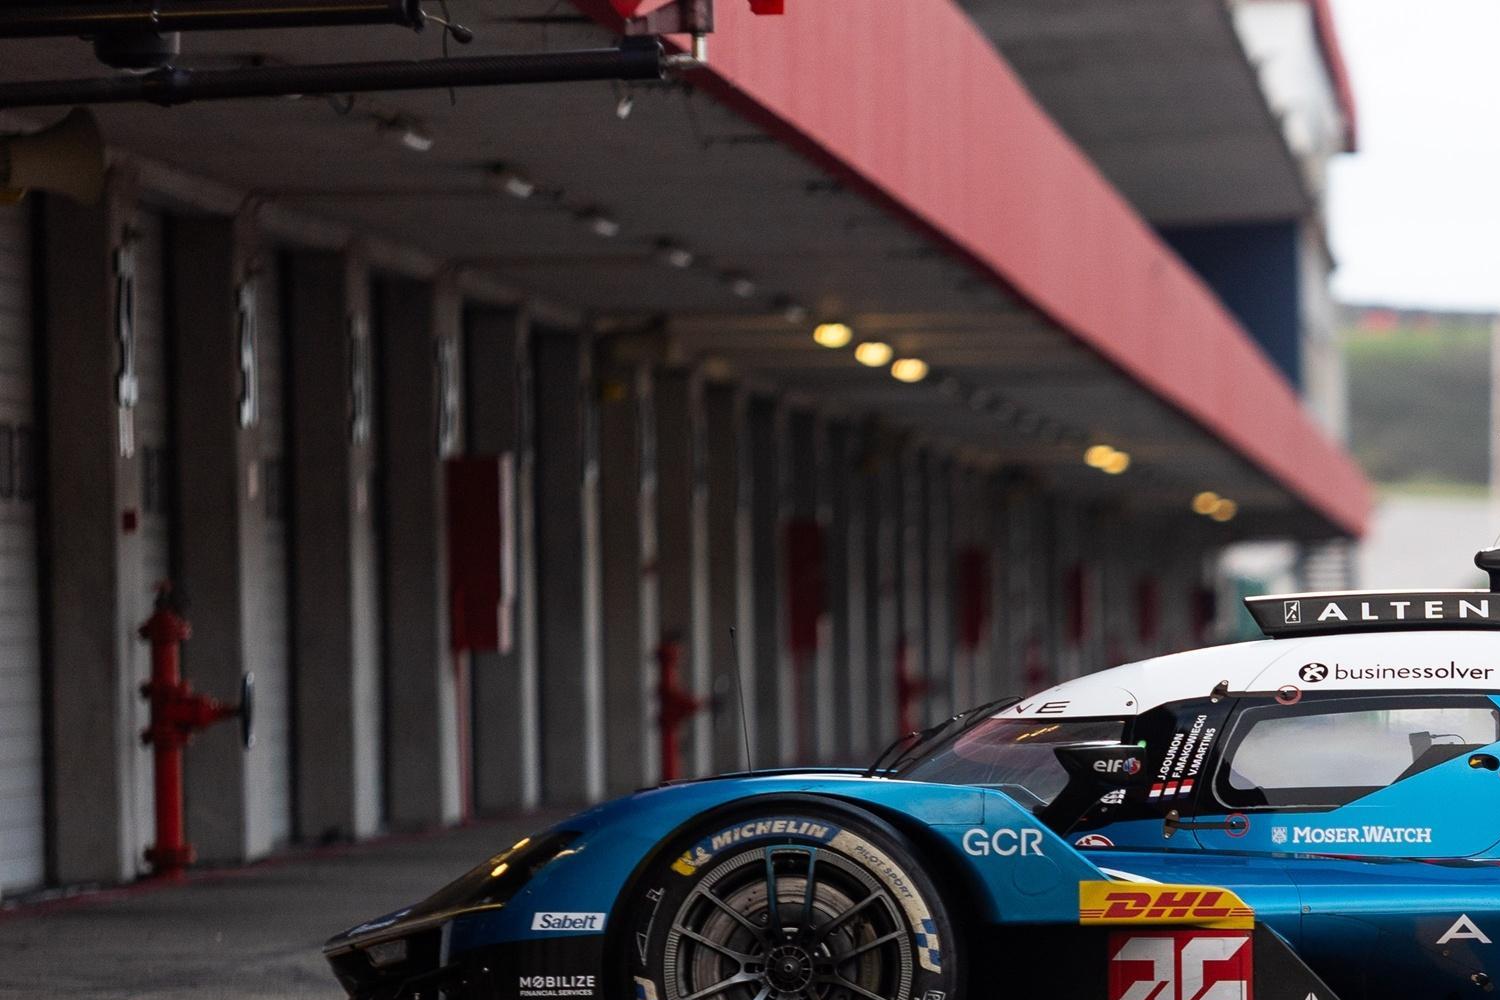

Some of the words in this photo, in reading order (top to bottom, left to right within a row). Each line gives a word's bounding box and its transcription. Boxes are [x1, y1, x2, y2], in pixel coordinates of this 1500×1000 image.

[1317, 600, 1489, 621] ALTEN
[1335, 661, 1494, 680] businessolver
[1157, 733, 1184, 780] J.GOUNON
[1172, 714, 1207, 778] F.MAKOWIECKI
[1187, 728, 1216, 776] V.MARTINS
[1093, 759, 1123, 772] elf
[712, 819, 828, 850] MICHELIN
[962, 828, 1045, 856] GCR
[855, 846, 885, 866] PILOT
[884, 868, 912, 898] SPORT
[1103, 891, 1231, 918] DHL
[540, 914, 597, 929] Sabelt
[558, 989, 593, 997] SERVICES
